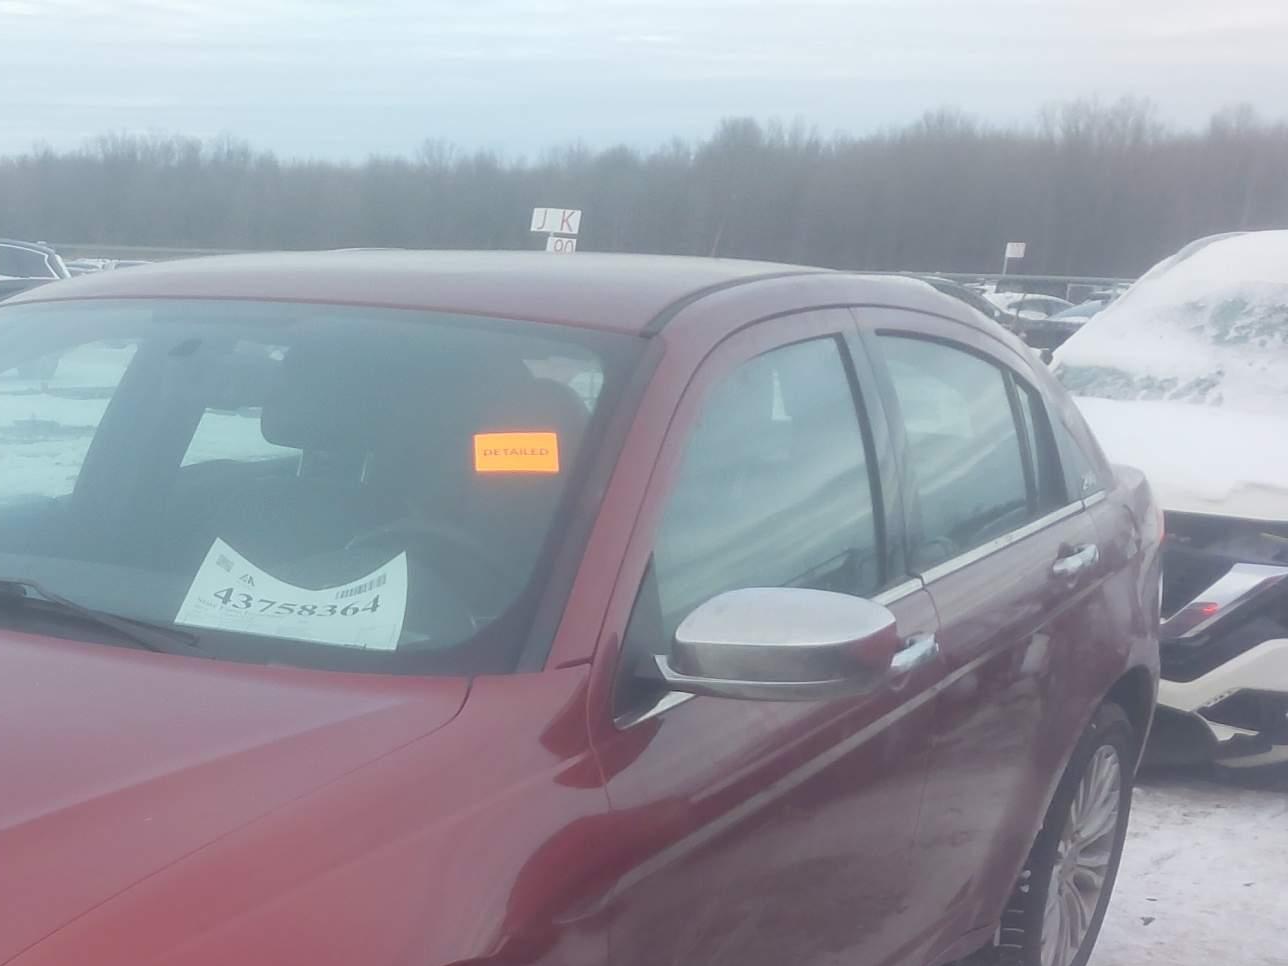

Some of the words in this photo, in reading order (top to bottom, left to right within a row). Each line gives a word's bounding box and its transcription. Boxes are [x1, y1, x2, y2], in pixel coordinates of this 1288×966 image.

[536, 208, 548, 230] J
[560, 209, 576, 232] K
[482, 447, 550, 457] DETAILED
[213, 587, 382, 617] 43758364
